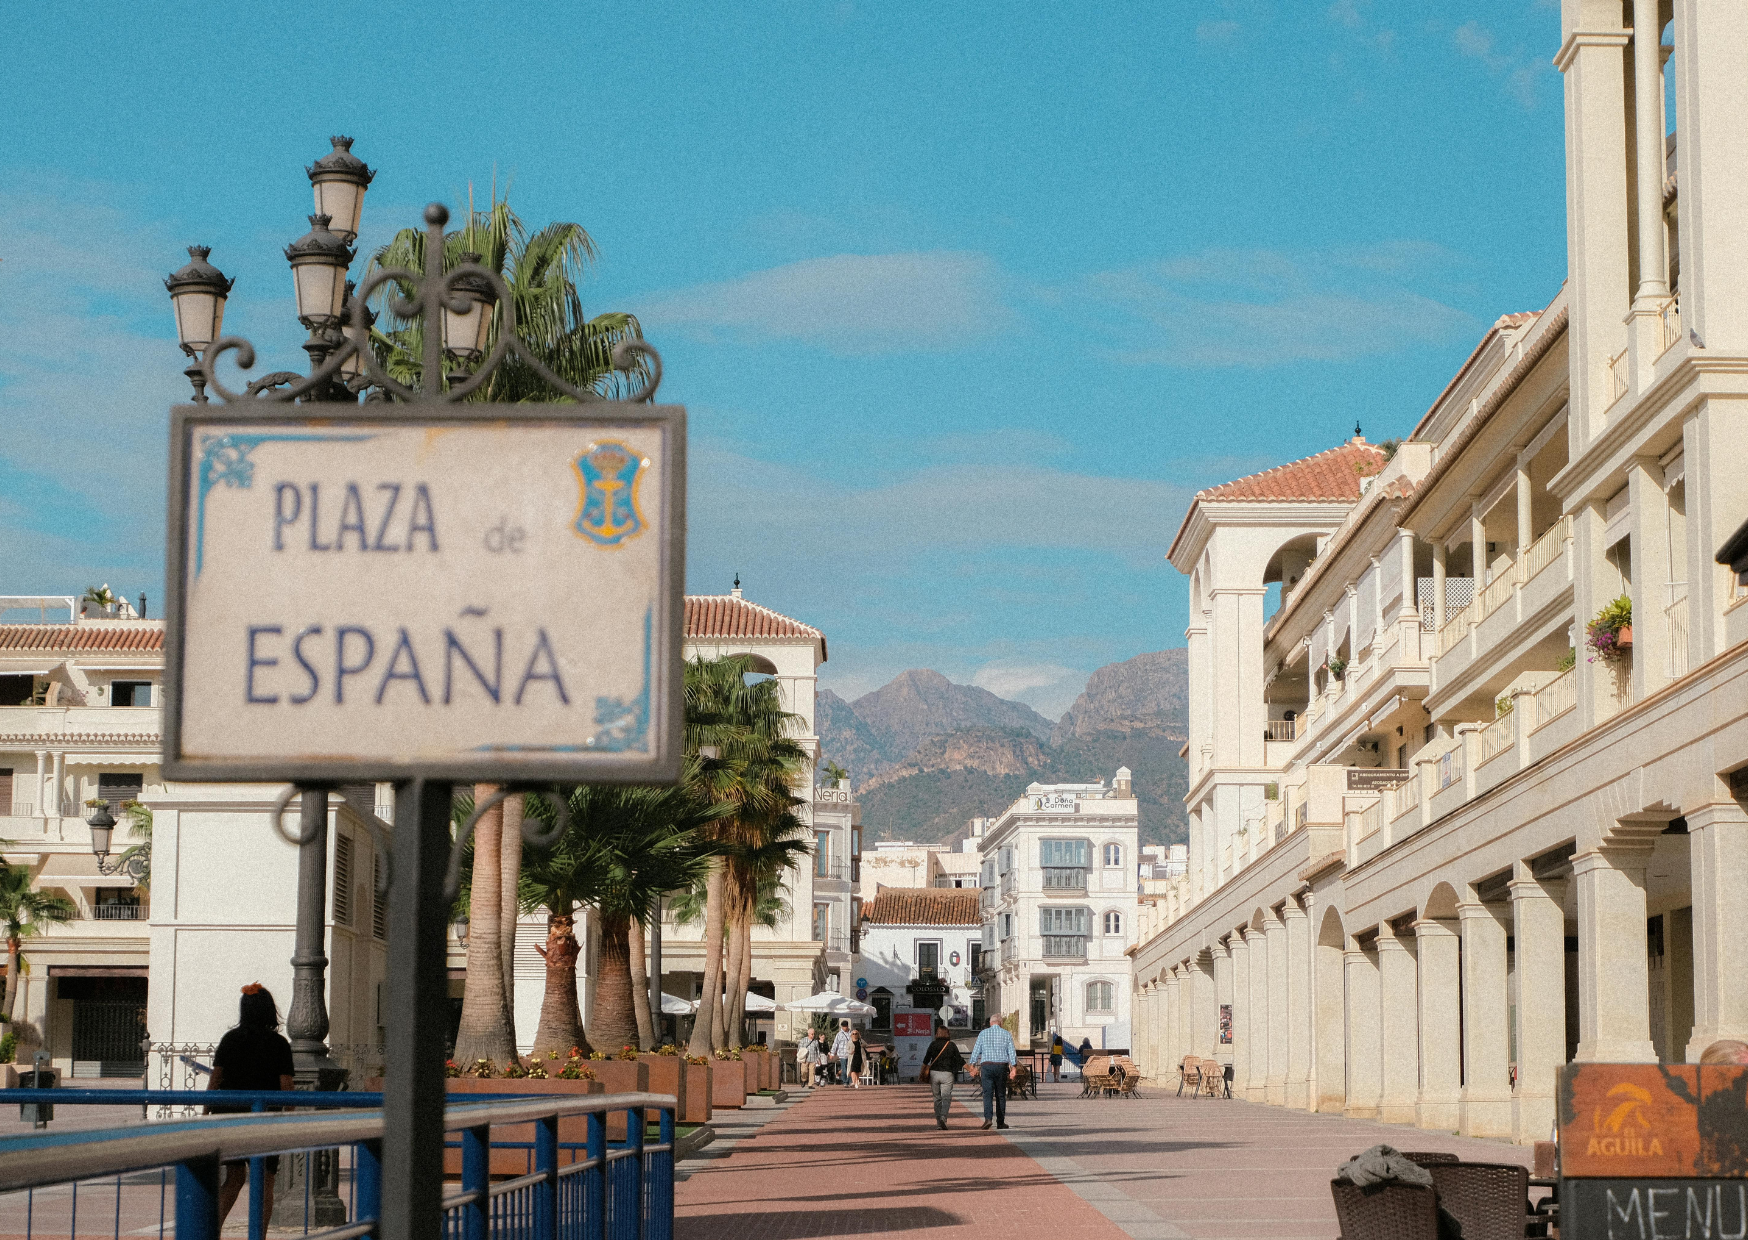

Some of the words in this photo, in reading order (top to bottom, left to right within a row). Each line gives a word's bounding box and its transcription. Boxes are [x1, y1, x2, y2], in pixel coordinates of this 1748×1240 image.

[272, 480, 440, 553] PLAZA
[483, 516, 527, 554] de
[244, 604, 571, 706] ESPAÑA
[814, 787, 848, 804] Nerja
[1587, 1137, 1664, 1157] AGUILA
[1606, 1184, 1747, 1240] MENU
